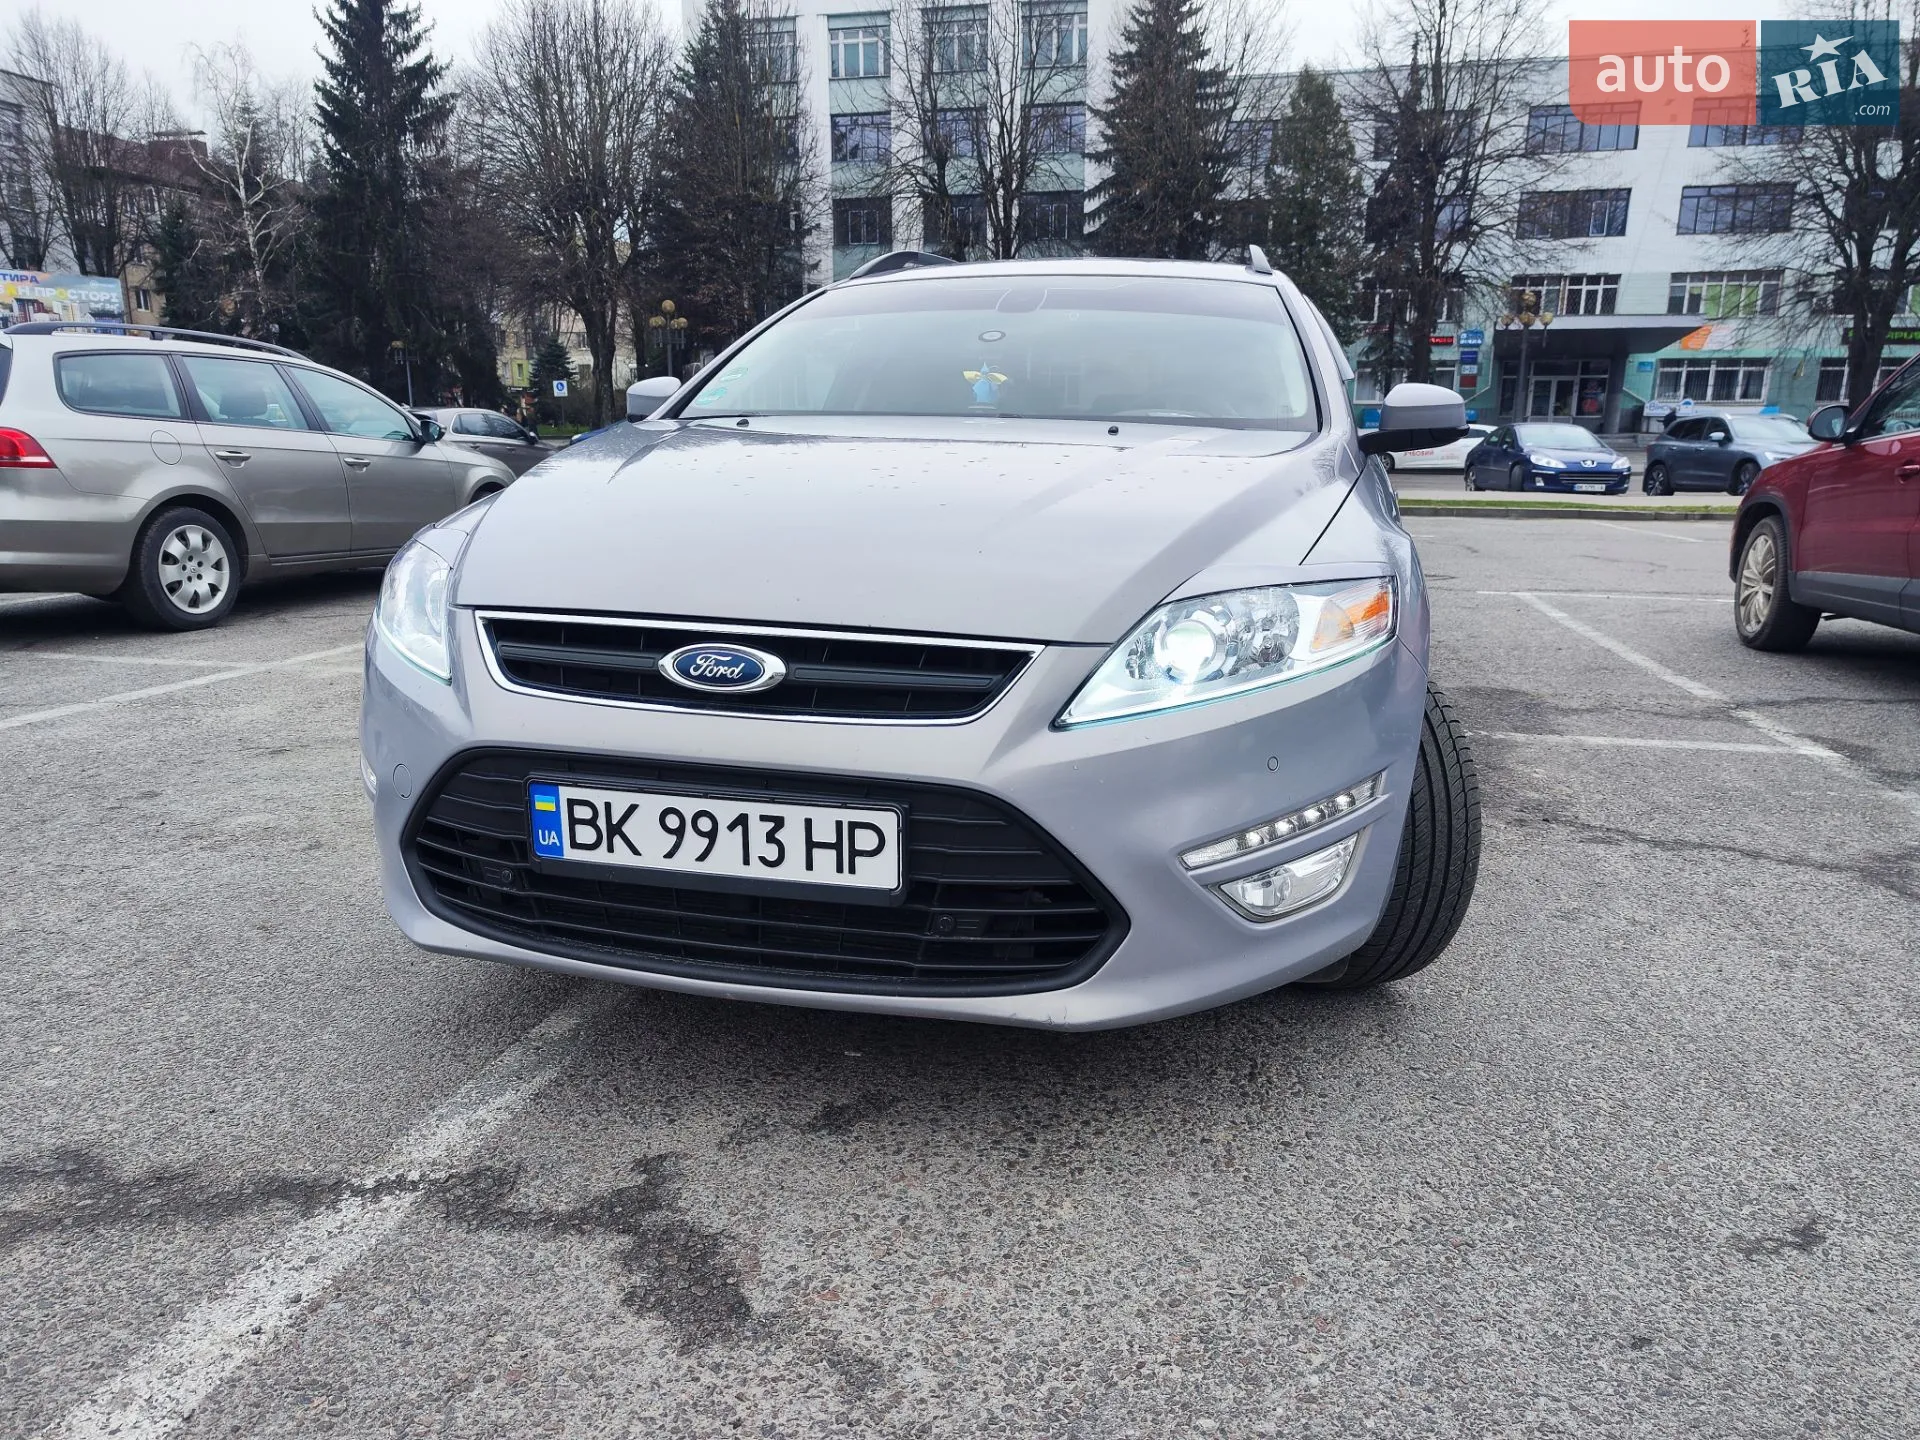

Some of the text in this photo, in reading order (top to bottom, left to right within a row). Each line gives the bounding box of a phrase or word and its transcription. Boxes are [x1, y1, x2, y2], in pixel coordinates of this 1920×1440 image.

[0, 272, 40, 285] ТИРА
[689, 652, 746, 681] Ford
[538, 828, 561, 847] UA
[566, 797, 887, 875] BK 9913 HP
